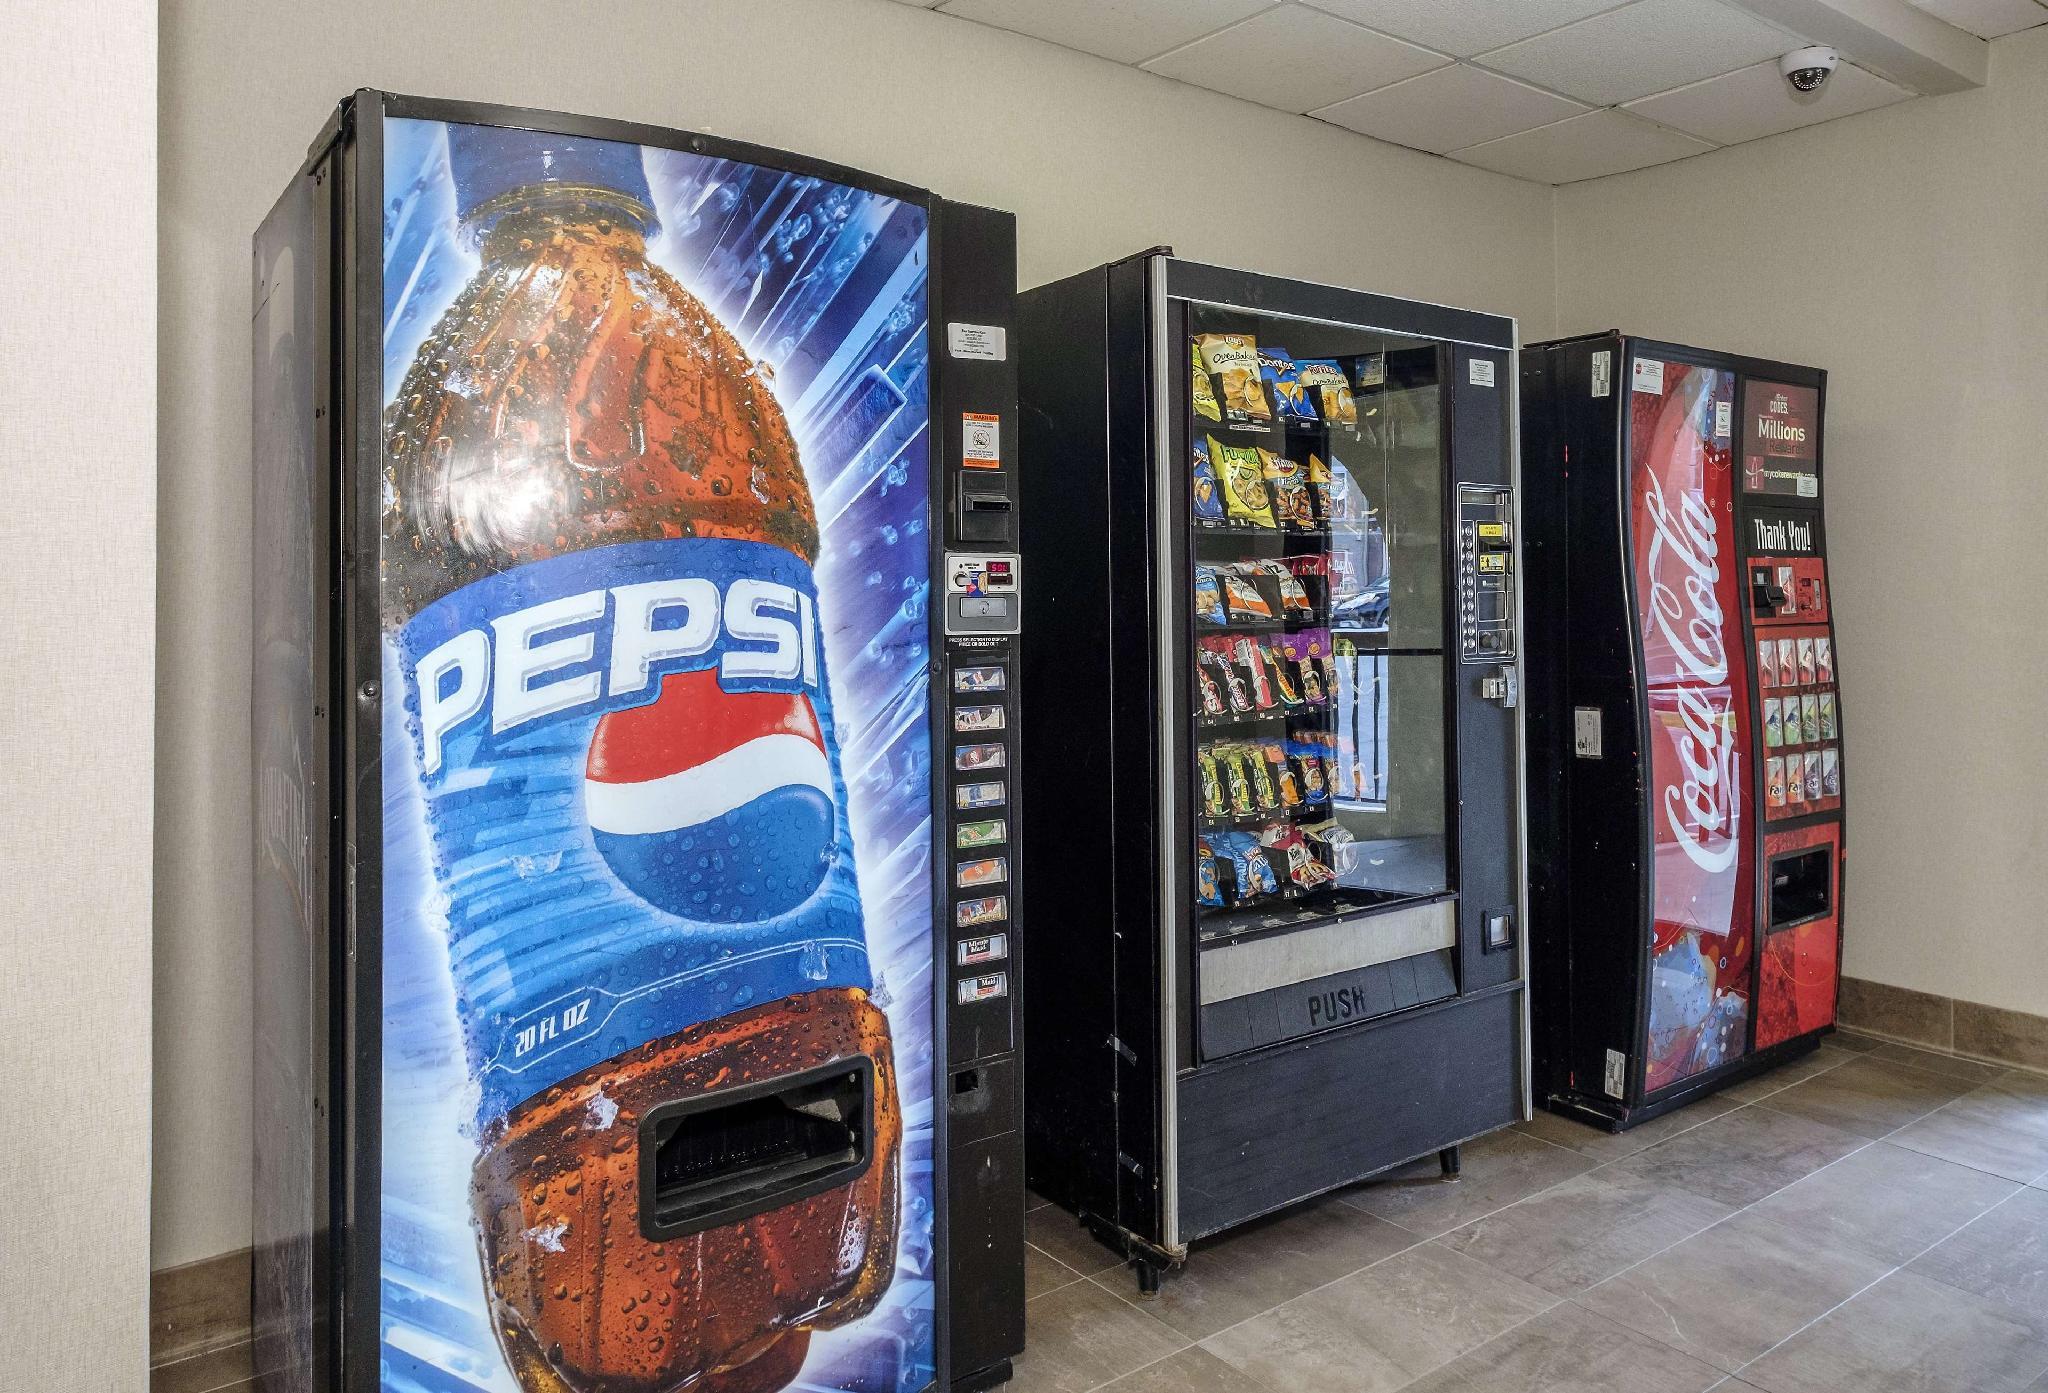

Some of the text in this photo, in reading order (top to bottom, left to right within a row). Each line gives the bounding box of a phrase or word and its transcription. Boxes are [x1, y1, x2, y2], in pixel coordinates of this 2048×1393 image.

[1257, 357, 1296, 370] Doritos
[1758, 418, 1806, 442] Millions
[1754, 518, 1811, 551] Thank You!
[414, 577, 818, 775] PEPSI
[1308, 985, 1367, 1027] PUSH
[515, 998, 591, 1058] 20 FL OZ
